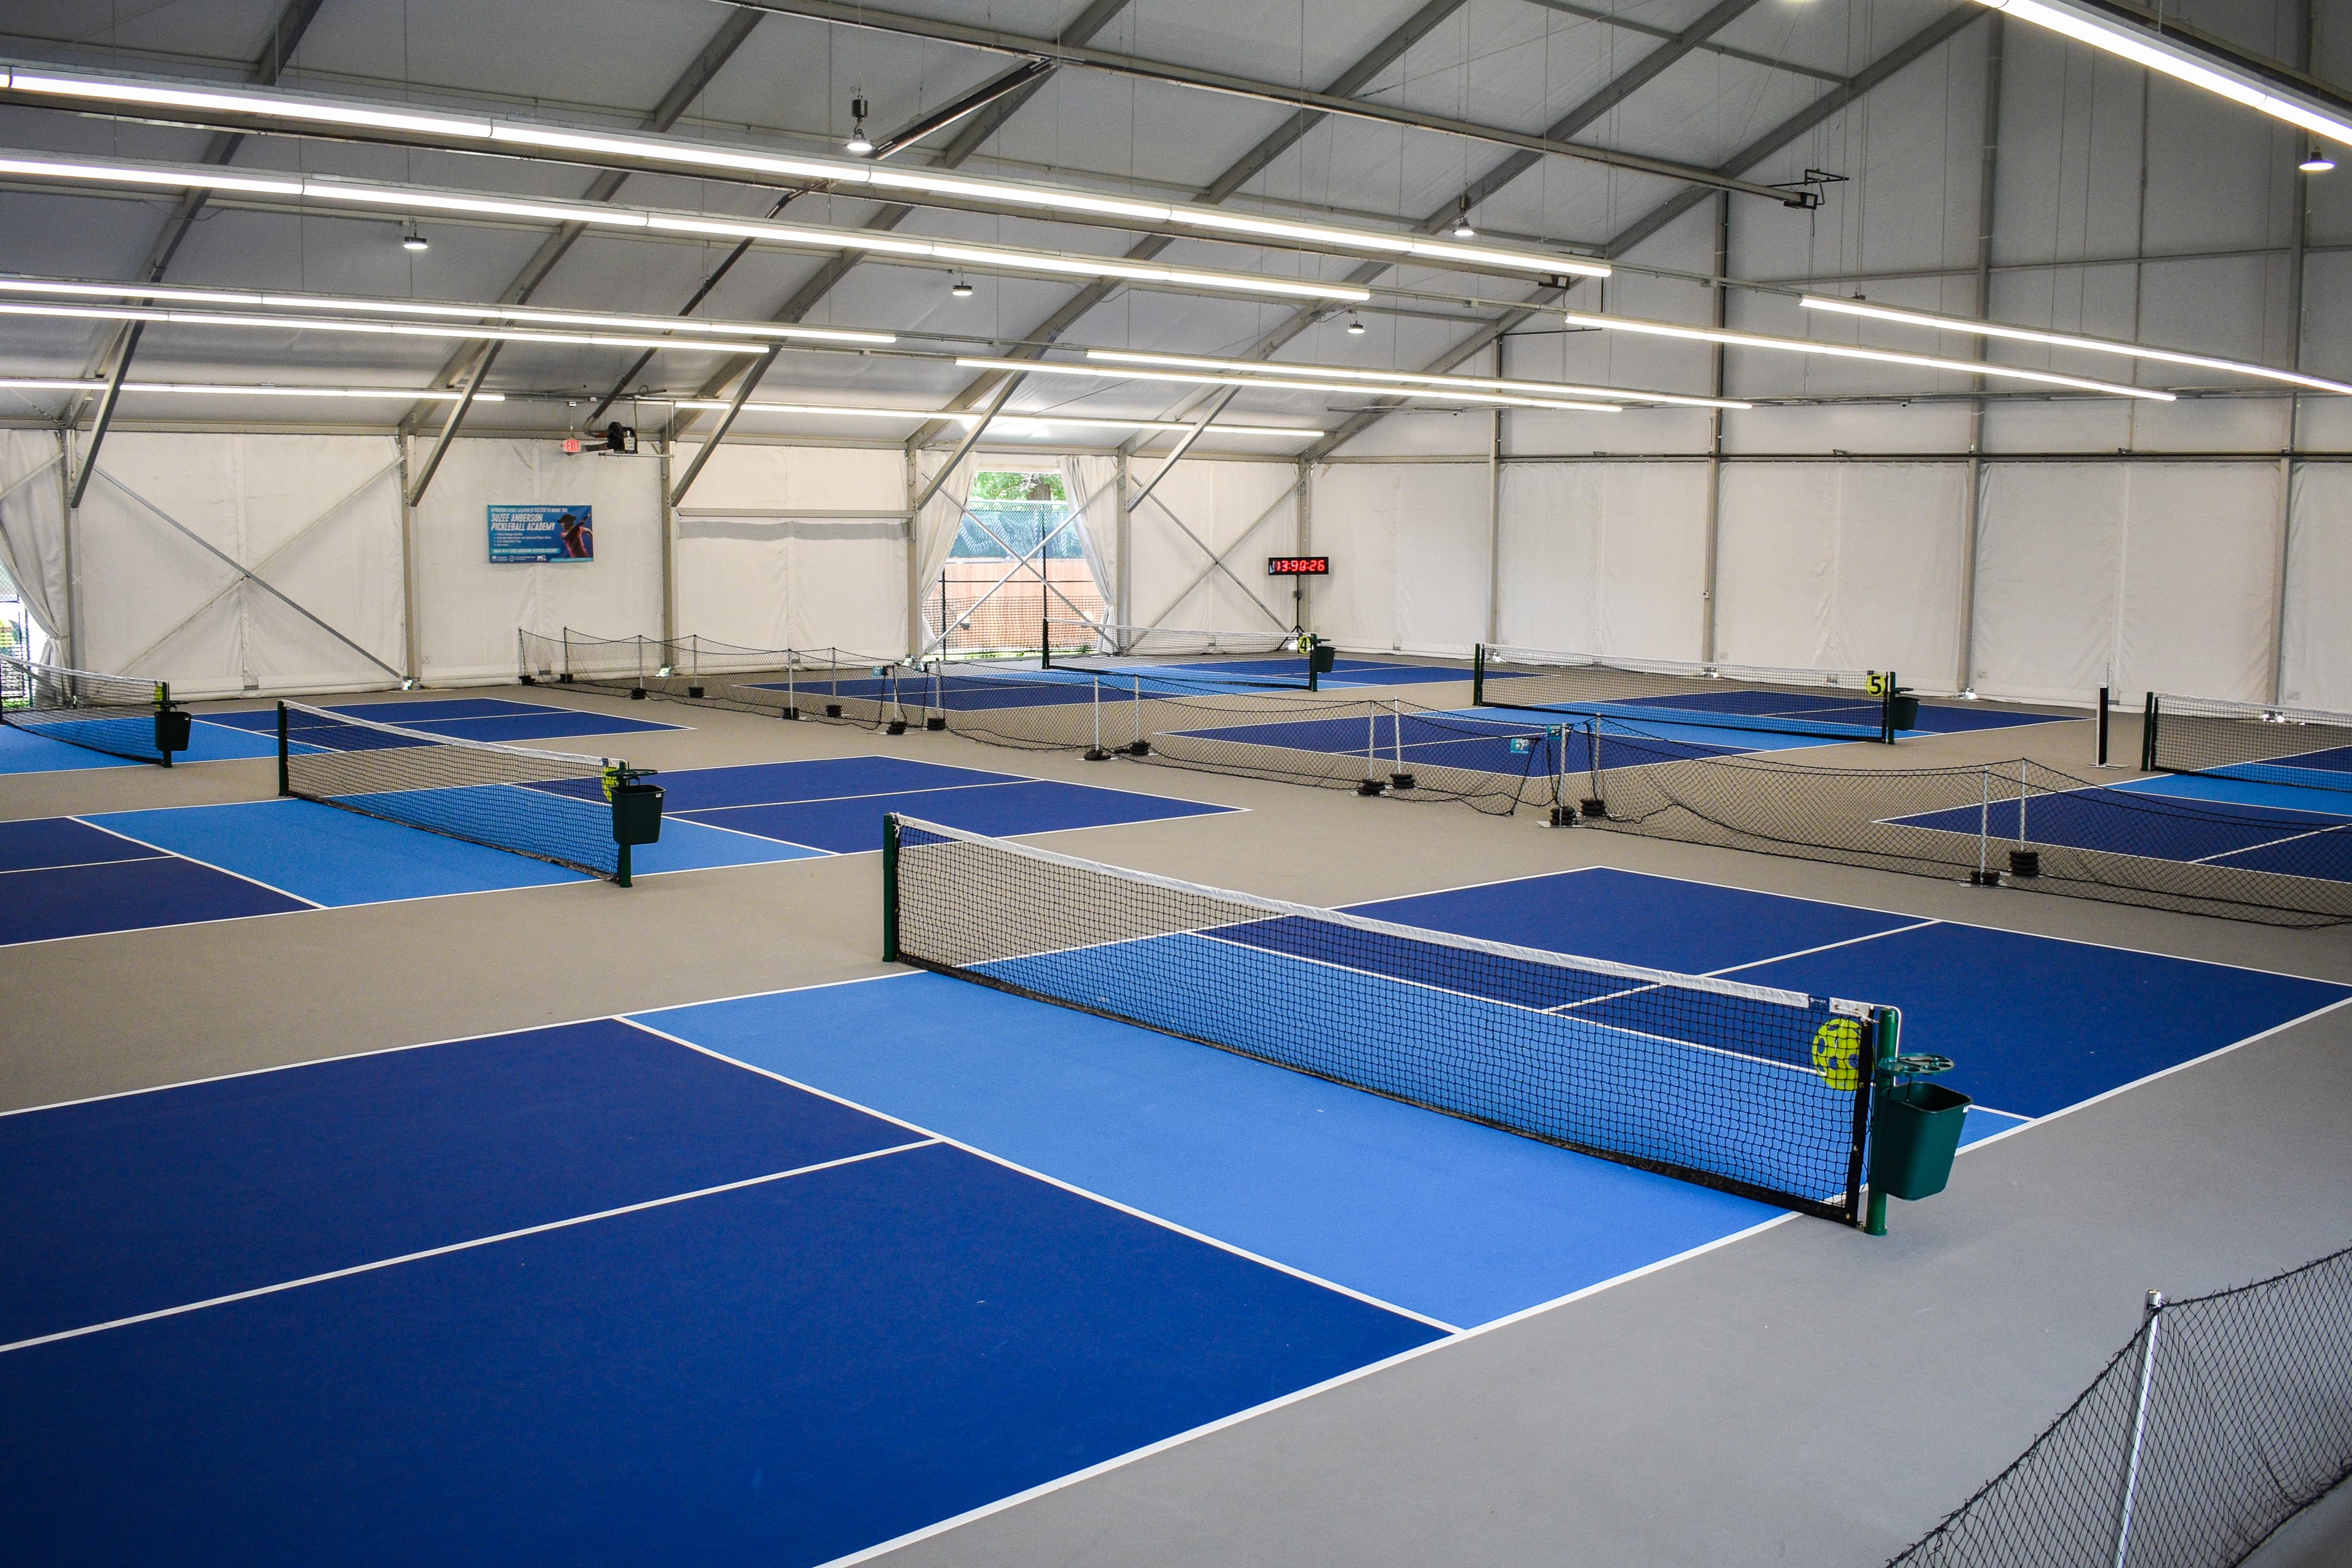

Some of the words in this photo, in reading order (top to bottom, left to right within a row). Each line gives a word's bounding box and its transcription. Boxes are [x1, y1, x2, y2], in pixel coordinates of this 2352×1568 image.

[567, 440, 579, 451] EXIT
[491, 513, 510, 522] SUZEE
[511, 513, 543, 522] ANDERSON
[491, 522, 526, 531] PICKLEBALL
[527, 522, 556, 531] ACADEMY
[1300, 637, 1308, 652] 4
[1870, 676, 1882, 695] 5
